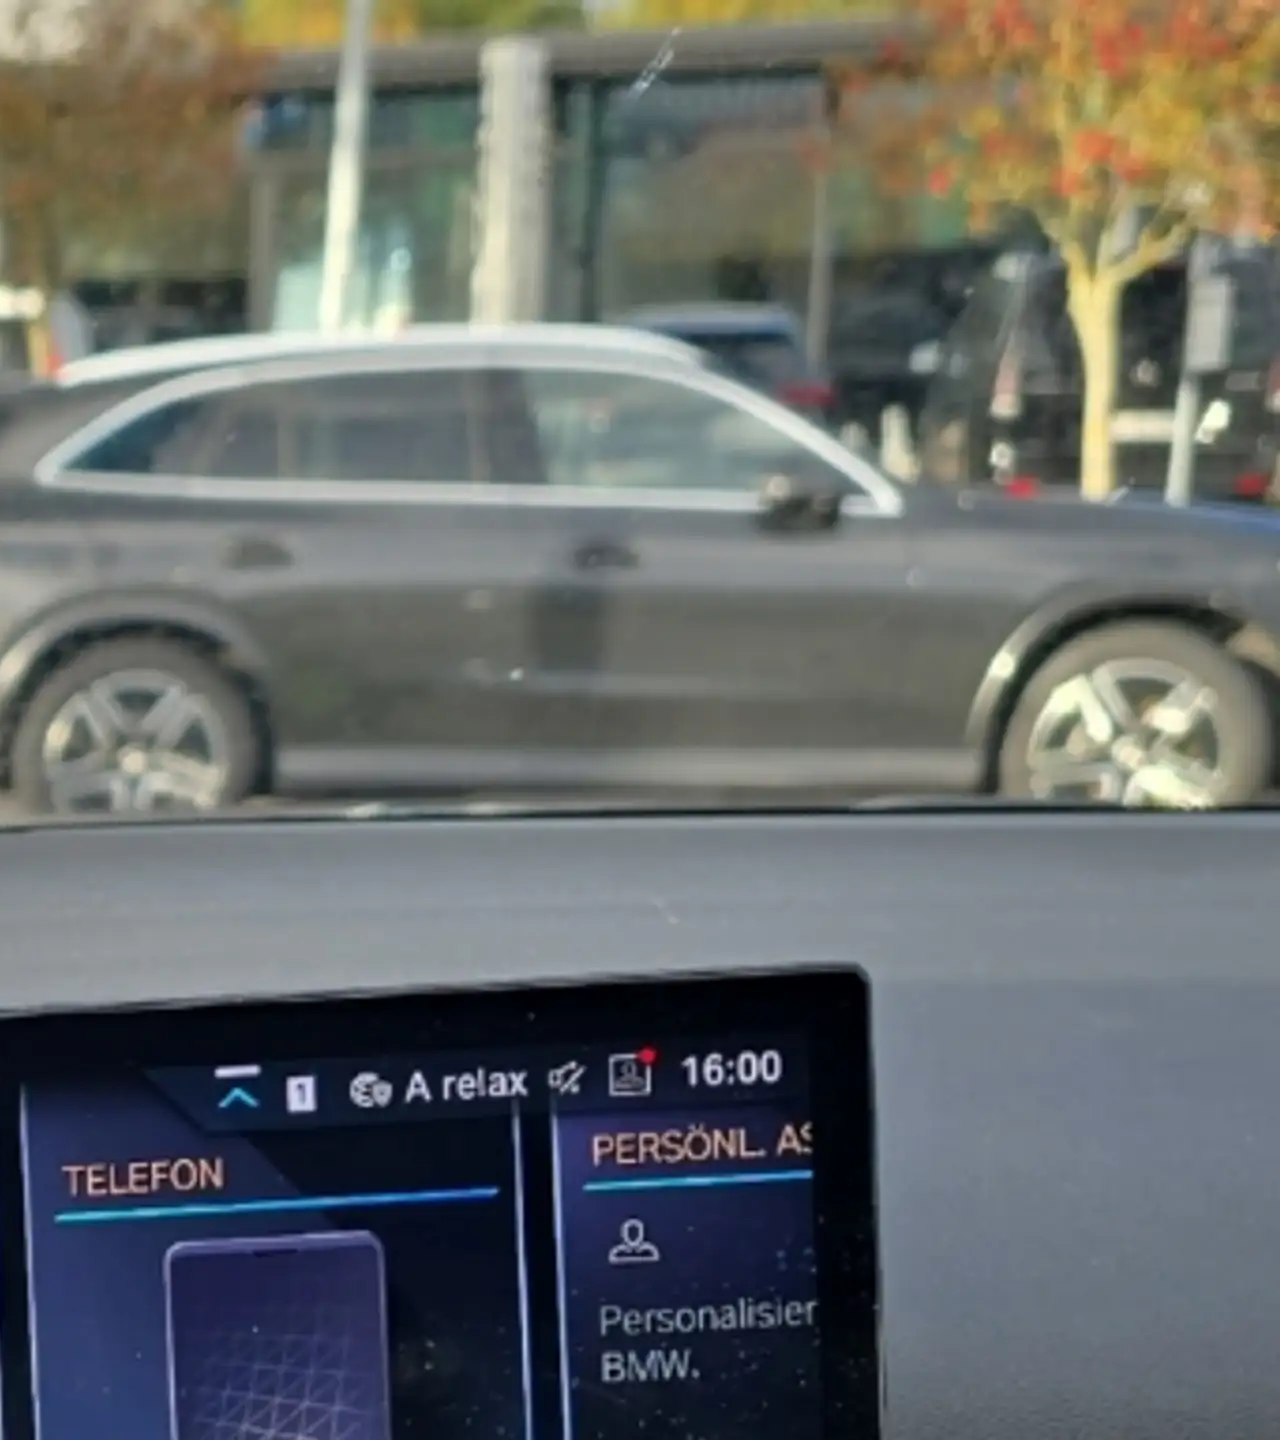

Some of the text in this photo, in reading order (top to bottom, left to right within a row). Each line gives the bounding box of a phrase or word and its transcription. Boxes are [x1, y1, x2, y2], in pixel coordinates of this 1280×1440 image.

[405, 1066, 529, 1103] A relax
[681, 1050, 783, 1087] 16:00
[592, 1124, 766, 1166] PERSÖNL.
[60, 1156, 224, 1197] TELEFON
[600, 1298, 818, 1336] Personalisier
[601, 1348, 700, 1383] BMW.
